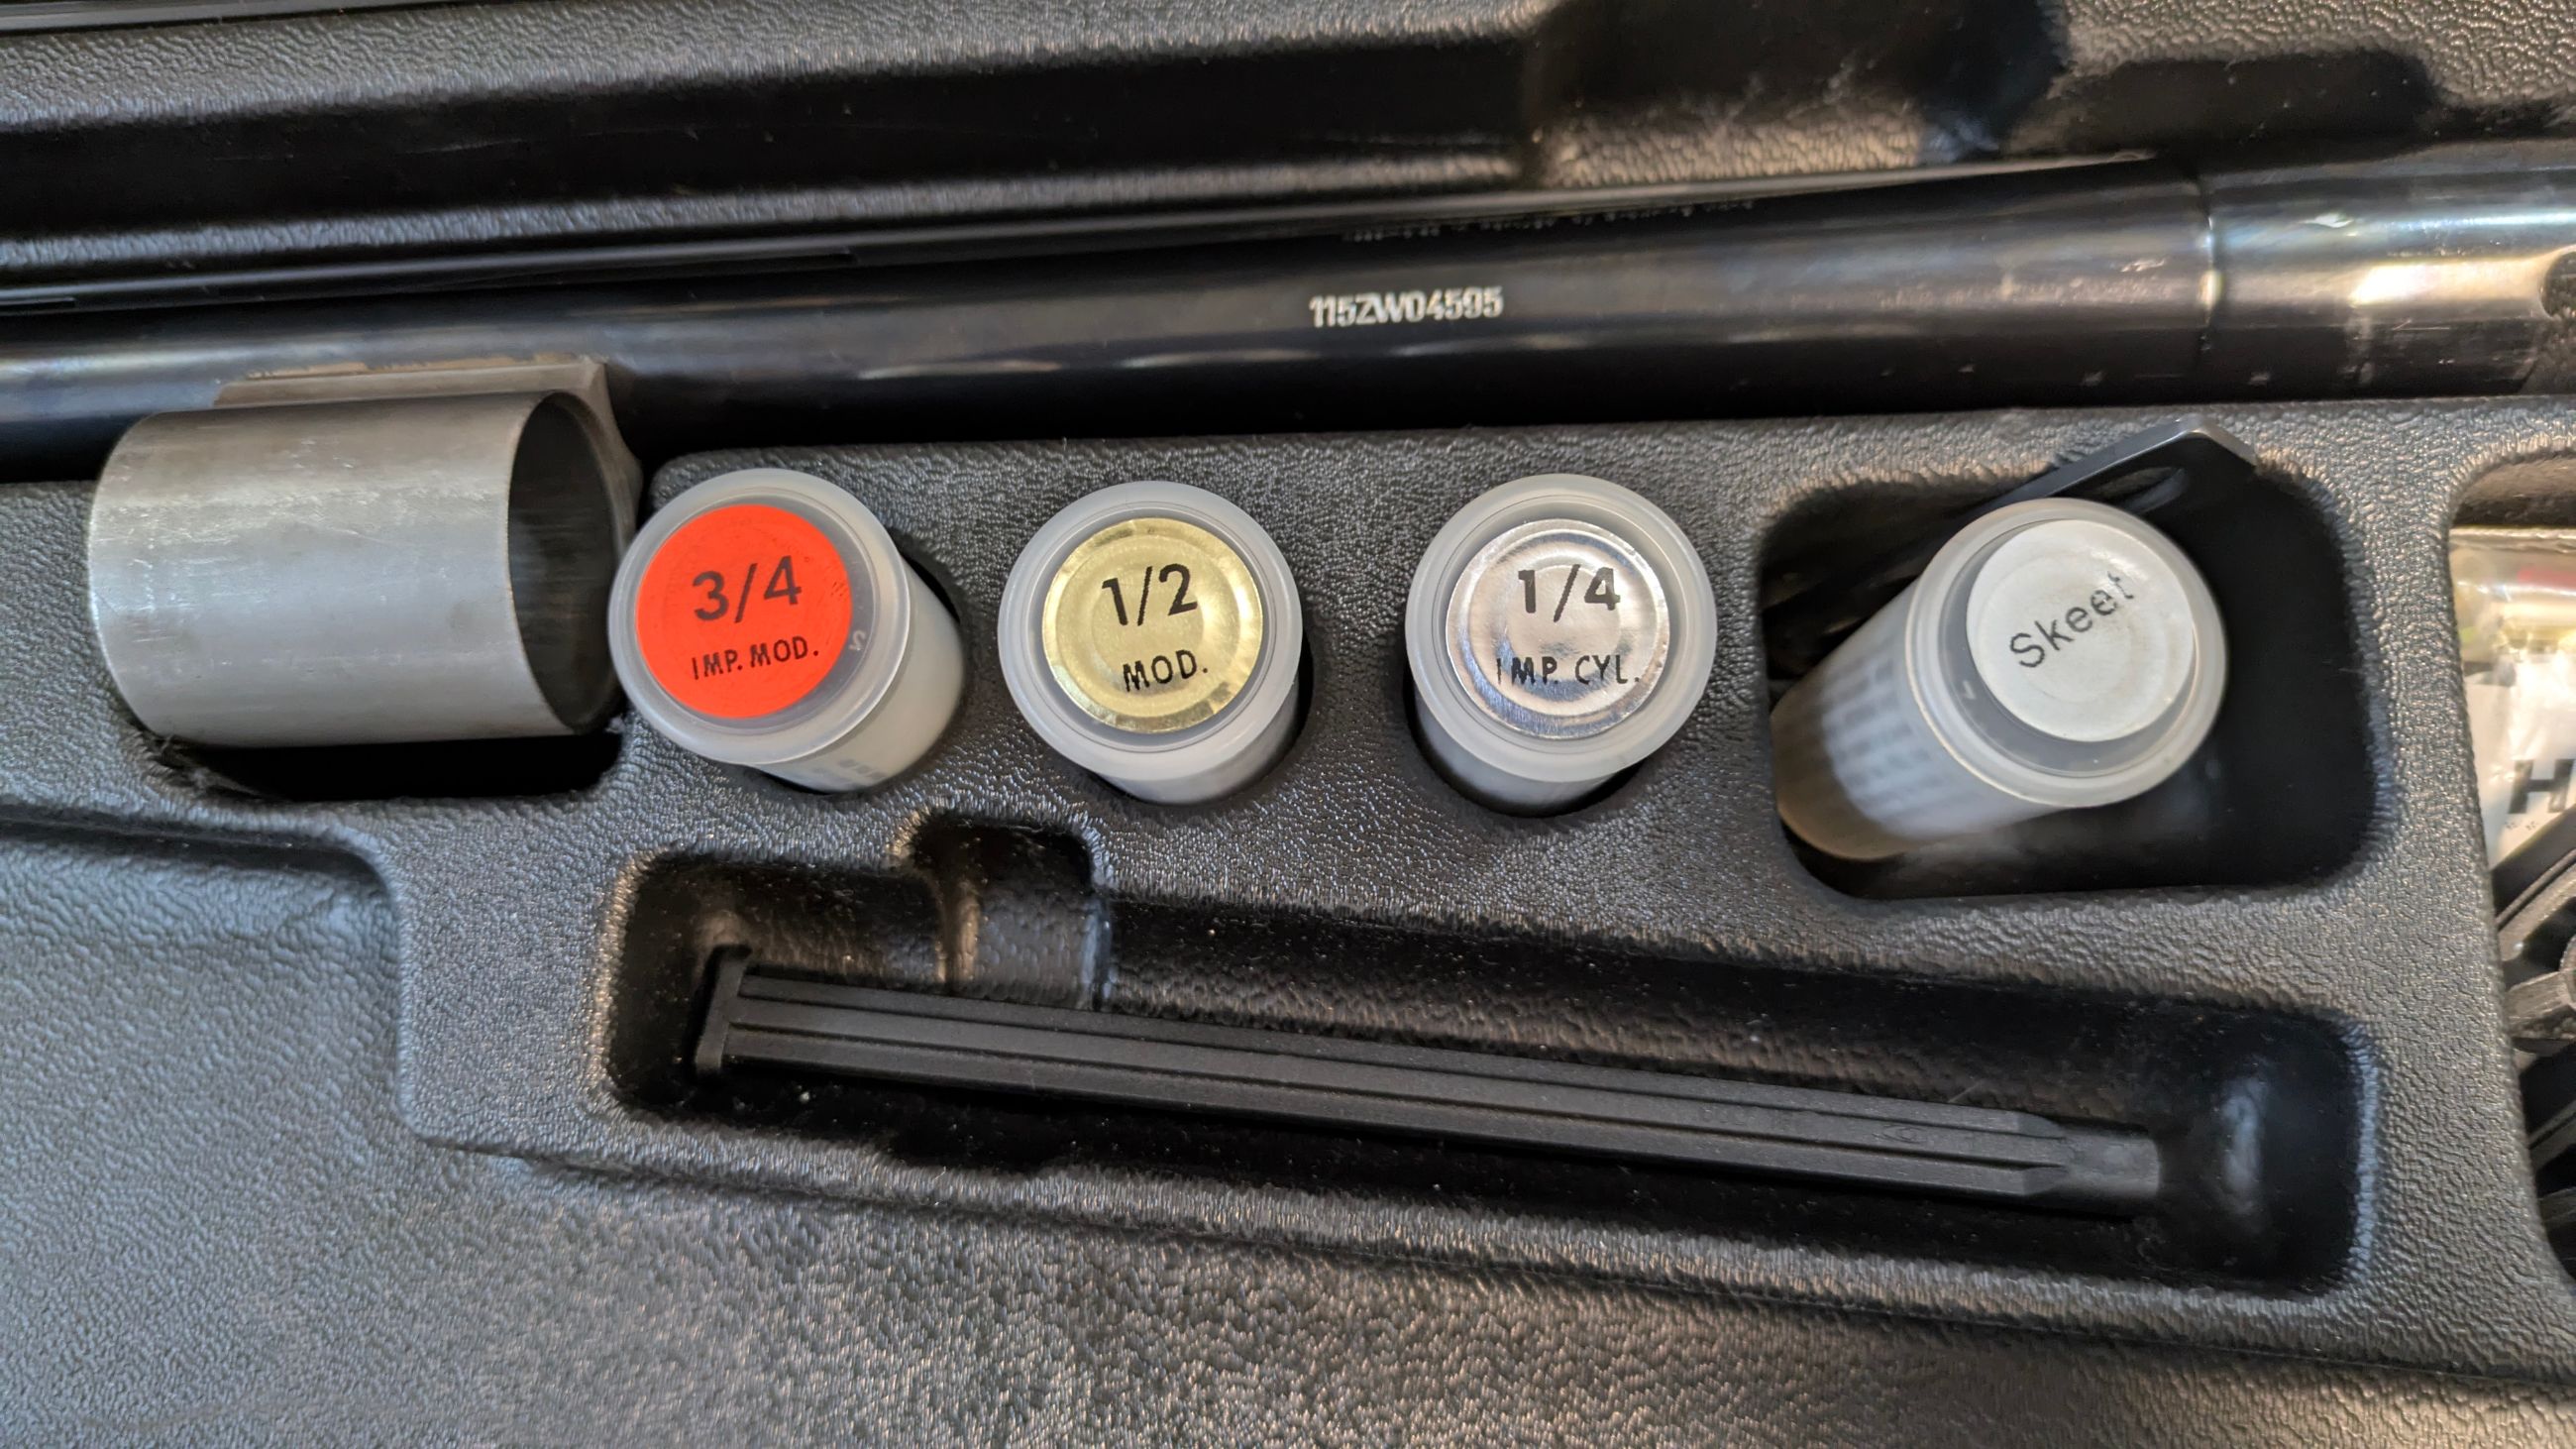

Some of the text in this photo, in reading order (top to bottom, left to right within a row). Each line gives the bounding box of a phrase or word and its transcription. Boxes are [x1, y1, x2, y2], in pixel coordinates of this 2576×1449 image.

[693, 555, 803, 623] 3/4
[1101, 564, 1198, 626] 1/2
[1518, 564, 1621, 622] 1/4
[2009, 571, 2134, 668] Skeet
[1122, 649, 1209, 692] MOD.
[1496, 654, 1640, 685] IMP. CYL.
